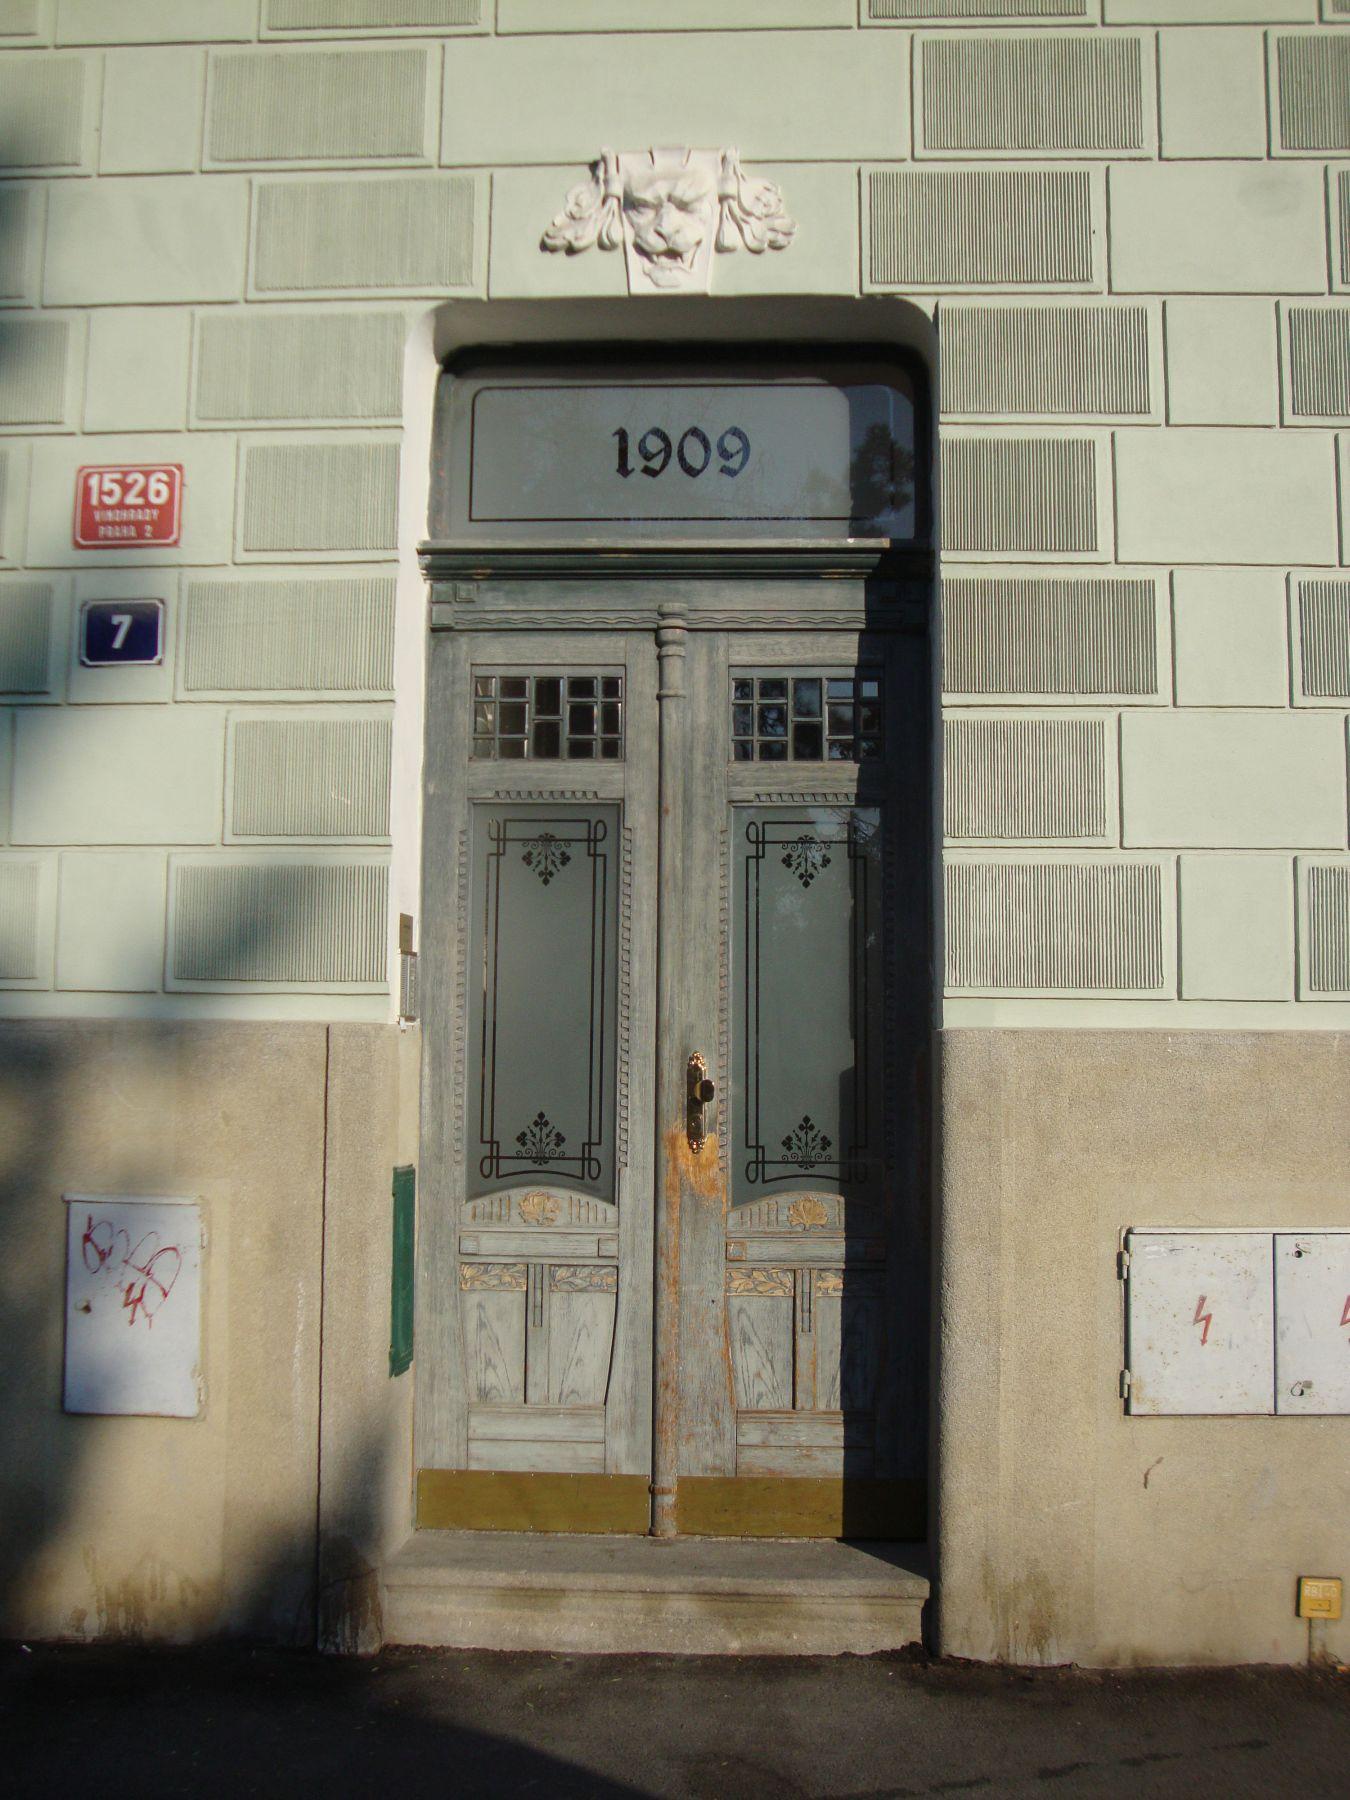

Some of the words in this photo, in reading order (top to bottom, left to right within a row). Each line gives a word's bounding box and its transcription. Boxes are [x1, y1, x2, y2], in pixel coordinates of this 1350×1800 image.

[611, 425, 751, 478] 1909
[87, 471, 170, 506] 1526
[144, 524, 153, 538] 2
[111, 614, 133, 649] 7
